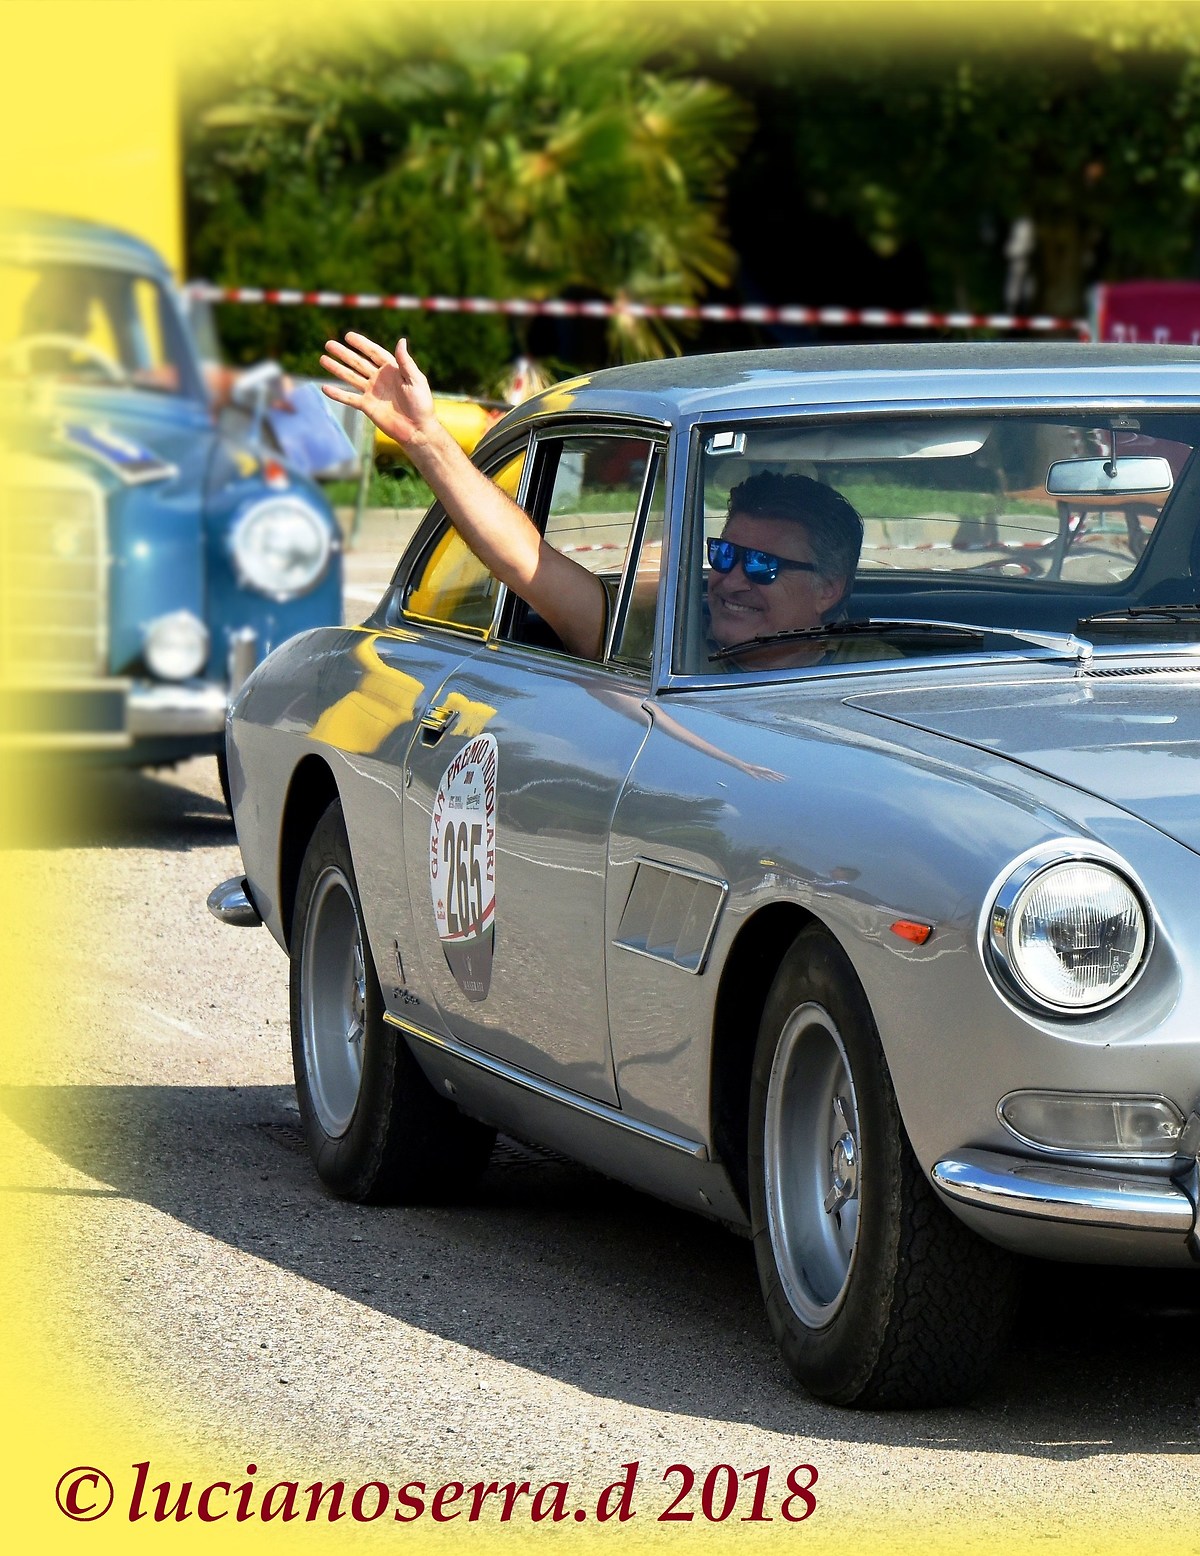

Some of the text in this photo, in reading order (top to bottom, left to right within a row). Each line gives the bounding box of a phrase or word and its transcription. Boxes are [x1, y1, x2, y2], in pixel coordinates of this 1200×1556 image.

[431, 788, 446, 880] GRAN
[447, 738, 490, 791] PREMIO
[481, 748, 496, 882] NUVOLARI
[443, 820, 483, 938] 265
